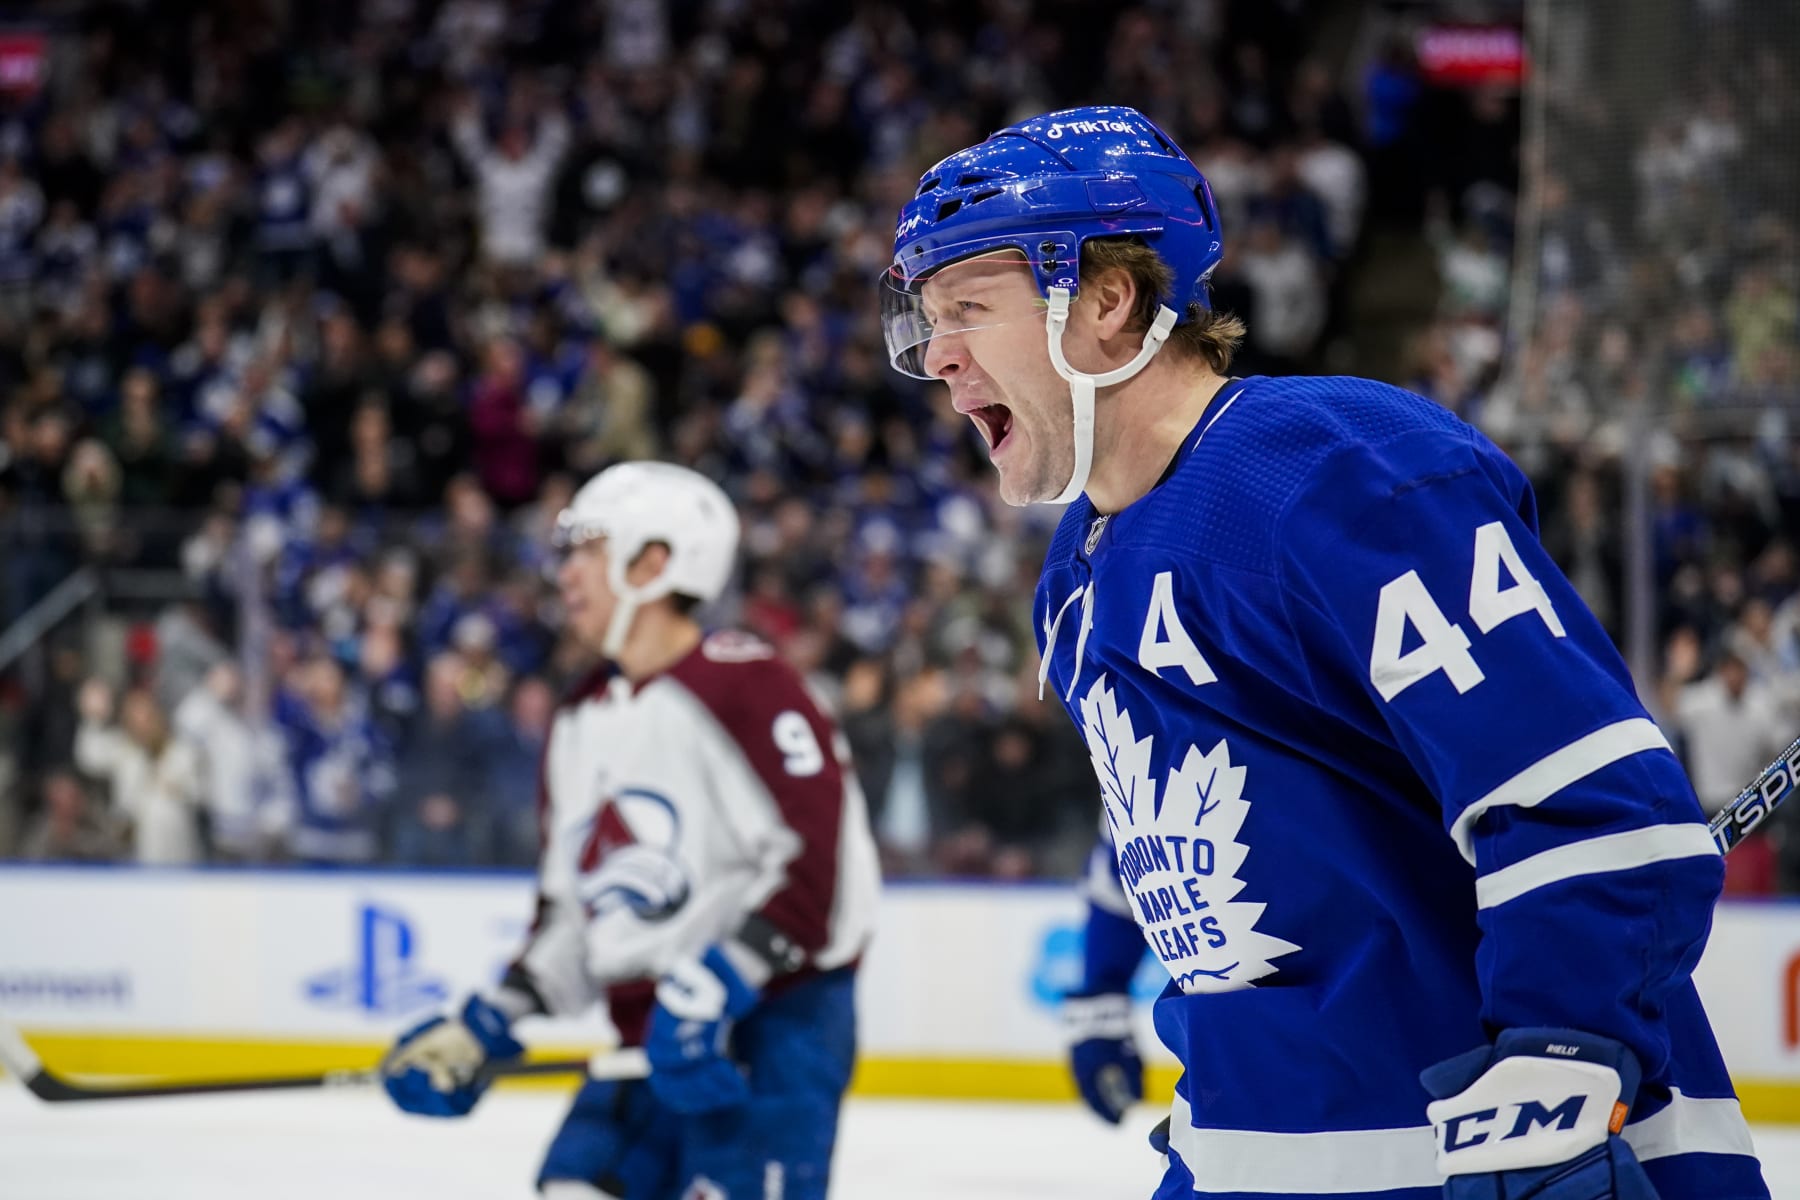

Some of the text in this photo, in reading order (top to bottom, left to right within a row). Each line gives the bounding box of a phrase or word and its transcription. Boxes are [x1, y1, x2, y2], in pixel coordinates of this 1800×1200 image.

[1066, 120, 1137, 135] TikTok
[1138, 571, 1218, 686] A
[1370, 521, 1567, 703] 44
[1119, 834, 1215, 896] TORONTO
[1135, 877, 1210, 924] MAPLE
[1151, 916, 1227, 962] LEAFS
[1435, 1094, 1588, 1153] CM
